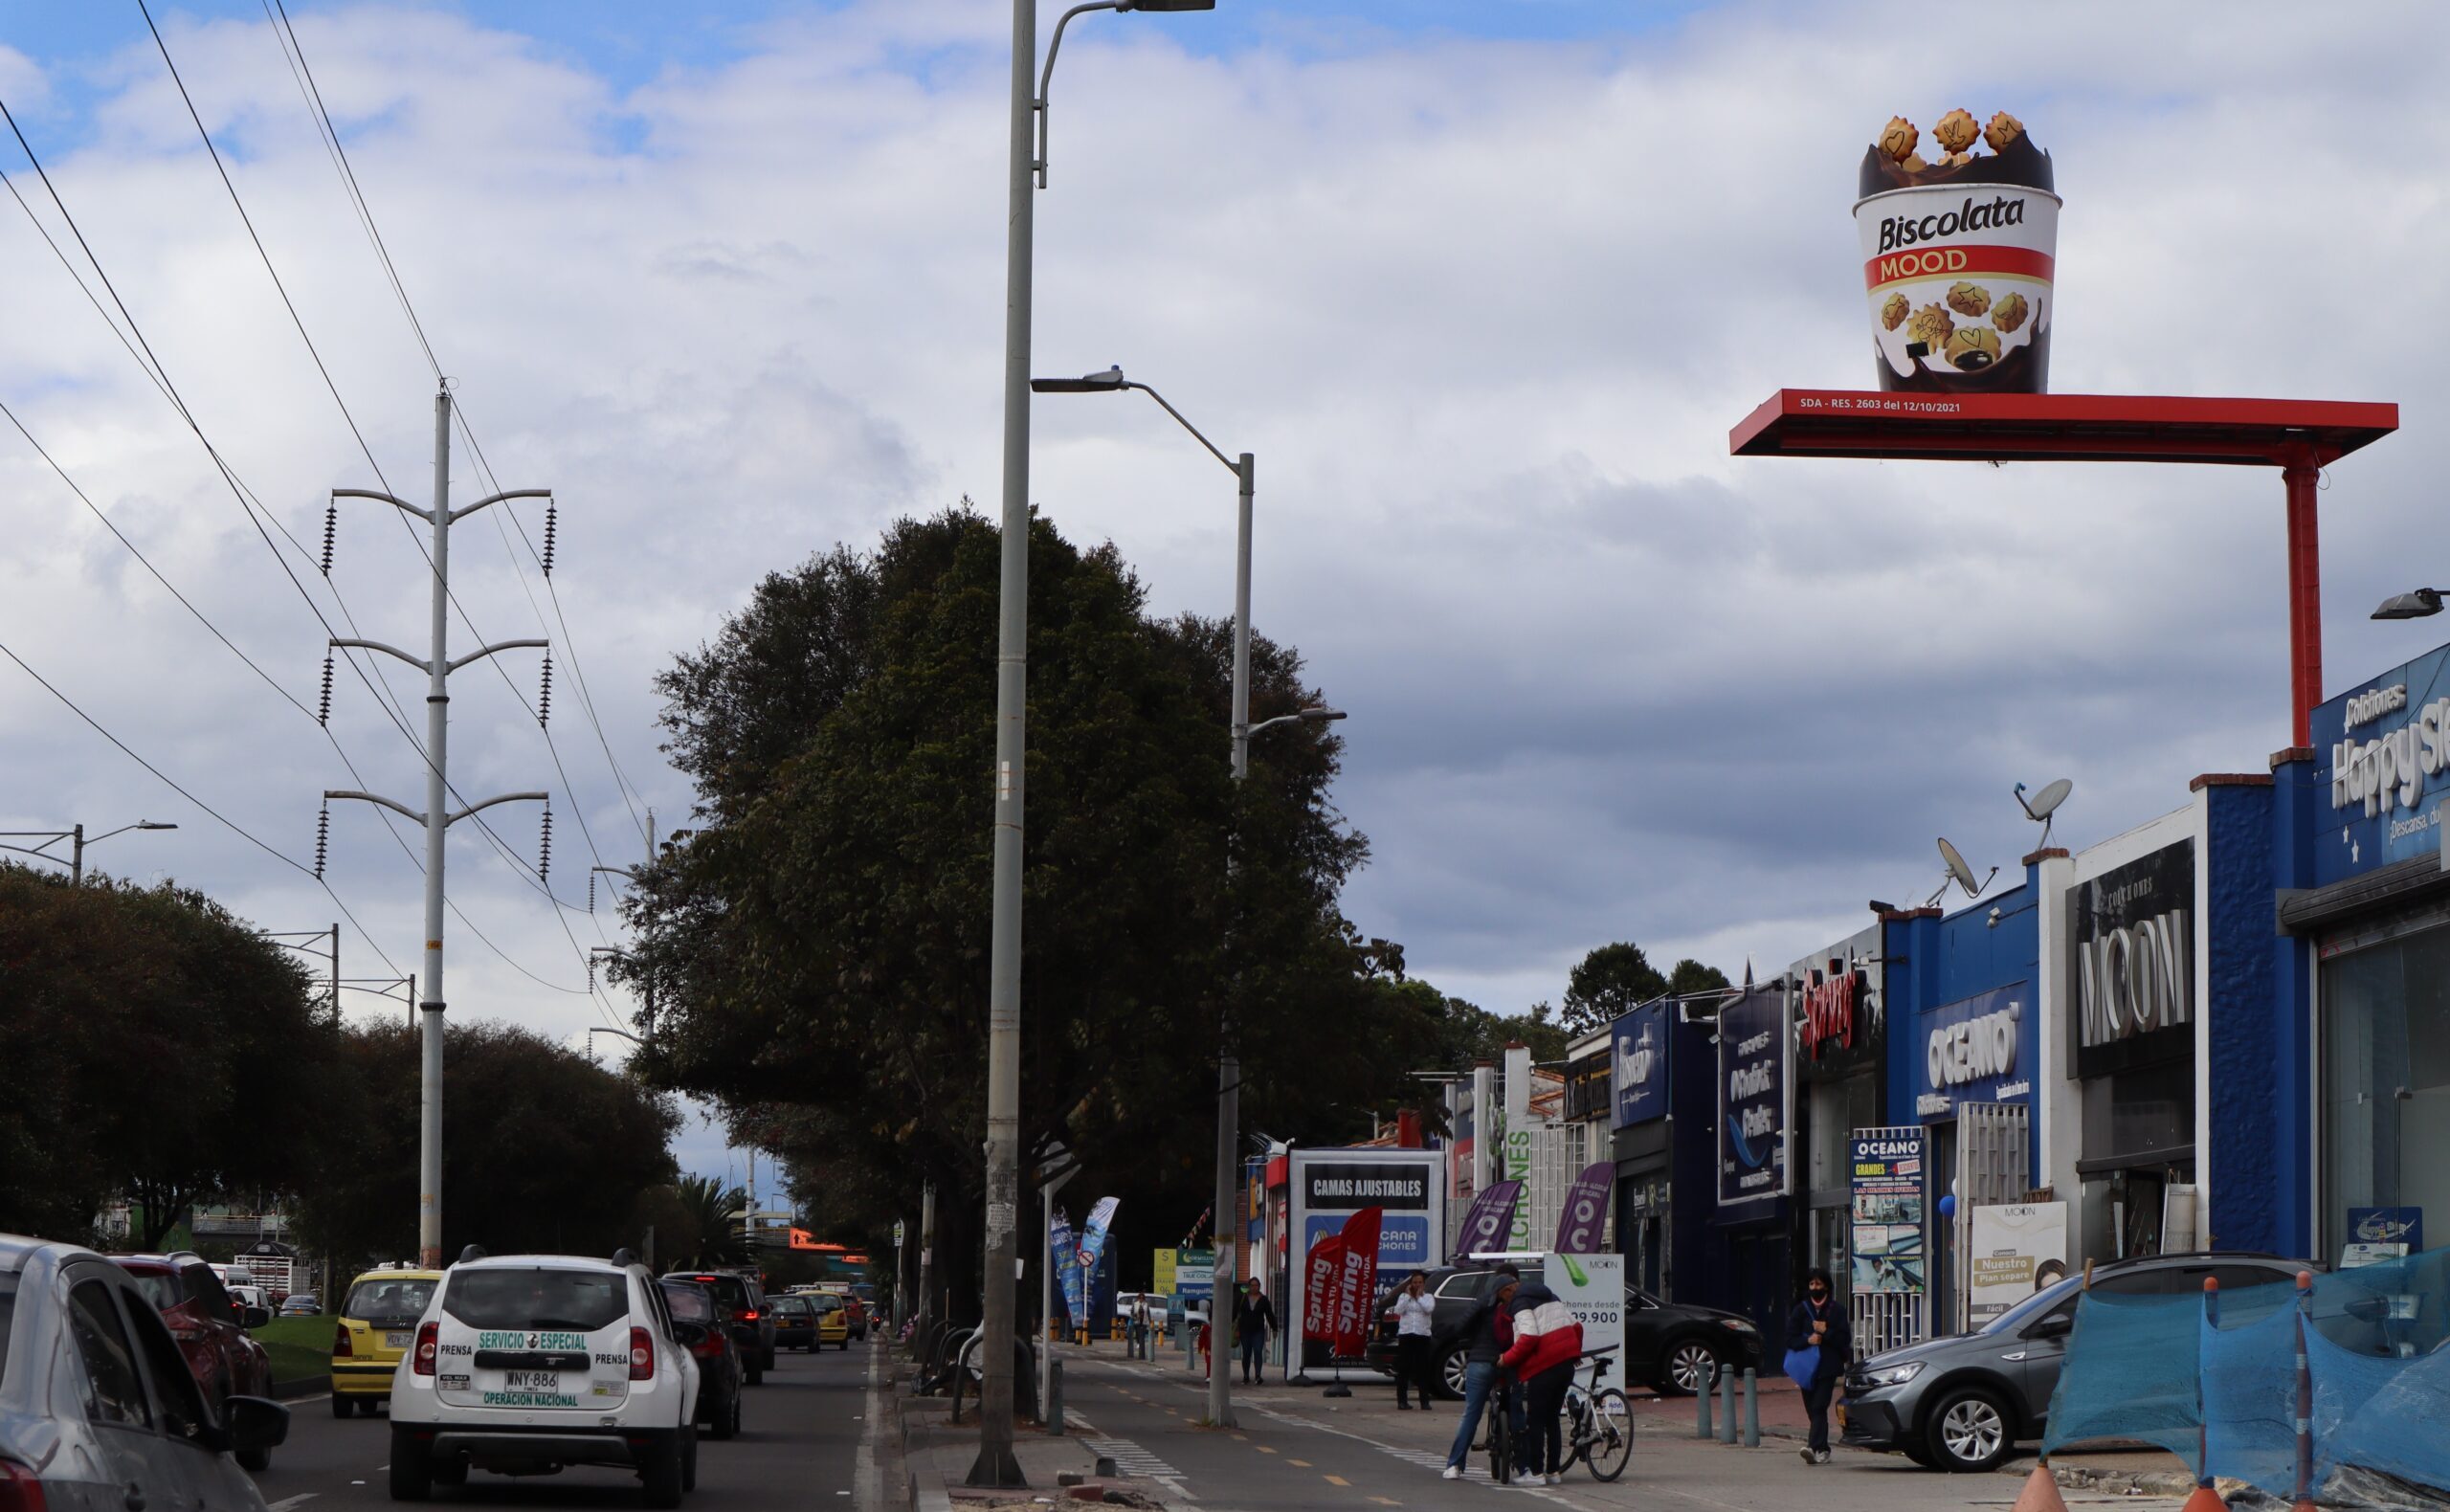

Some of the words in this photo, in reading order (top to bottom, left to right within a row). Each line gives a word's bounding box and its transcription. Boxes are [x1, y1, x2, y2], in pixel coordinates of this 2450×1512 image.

[1878, 195, 2025, 256] Biscolata
[1880, 250, 1969, 282] MOOD
[1800, 397, 1822, 409] SDA
[1832, 398, 1854, 409] RES.
[1856, 398, 1882, 410] 2603
[1883, 399, 1901, 411] del
[1903, 400, 1961, 413] 12/10/2021
[2347, 685, 2407, 726] Colchones
[2108, 876, 2153, 909] COLCHONES
[2079, 909, 2193, 1048] MOON
[1927, 1010, 2017, 1089] OCEANO
[1858, 1141, 1919, 1156] OCEANO
[1855, 1163, 1885, 1176] GRANDES
[1313, 1178, 1353, 1197] CAMAS
[1354, 1179, 1422, 1197] AJUSTABLES
[2005, 1207, 2037, 1217] MOON
[1379, 1231, 1417, 1241] CANA
[1589, 1260, 1618, 1269] MOON
[1982, 1257, 2028, 1270] Nuestro
[1978, 1274, 1999, 1283] Plan
[1999, 1272, 2030, 1283] separe
[1306, 1256, 1332, 1333] Spring
[1328, 1285, 1337, 1298] TU
[1338, 1251, 1363, 1334] Spring
[1361, 1283, 1370, 1296] TU
[1986, 1303, 2004, 1313] Fácil
[1325, 1300, 1335, 1334] CAMBIA
[1357, 1298, 1368, 1335] CAMBIA
[479, 1332, 524, 1349] SERVICIO
[540, 1333, 587, 1350] ESPECIAL
[440, 1345, 473, 1356] PRENSA
[595, 1353, 629, 1365] PRENSA
[483, 1392, 533, 1406] OPERACION
[534, 1393, 578, 1407] NACIONAL
